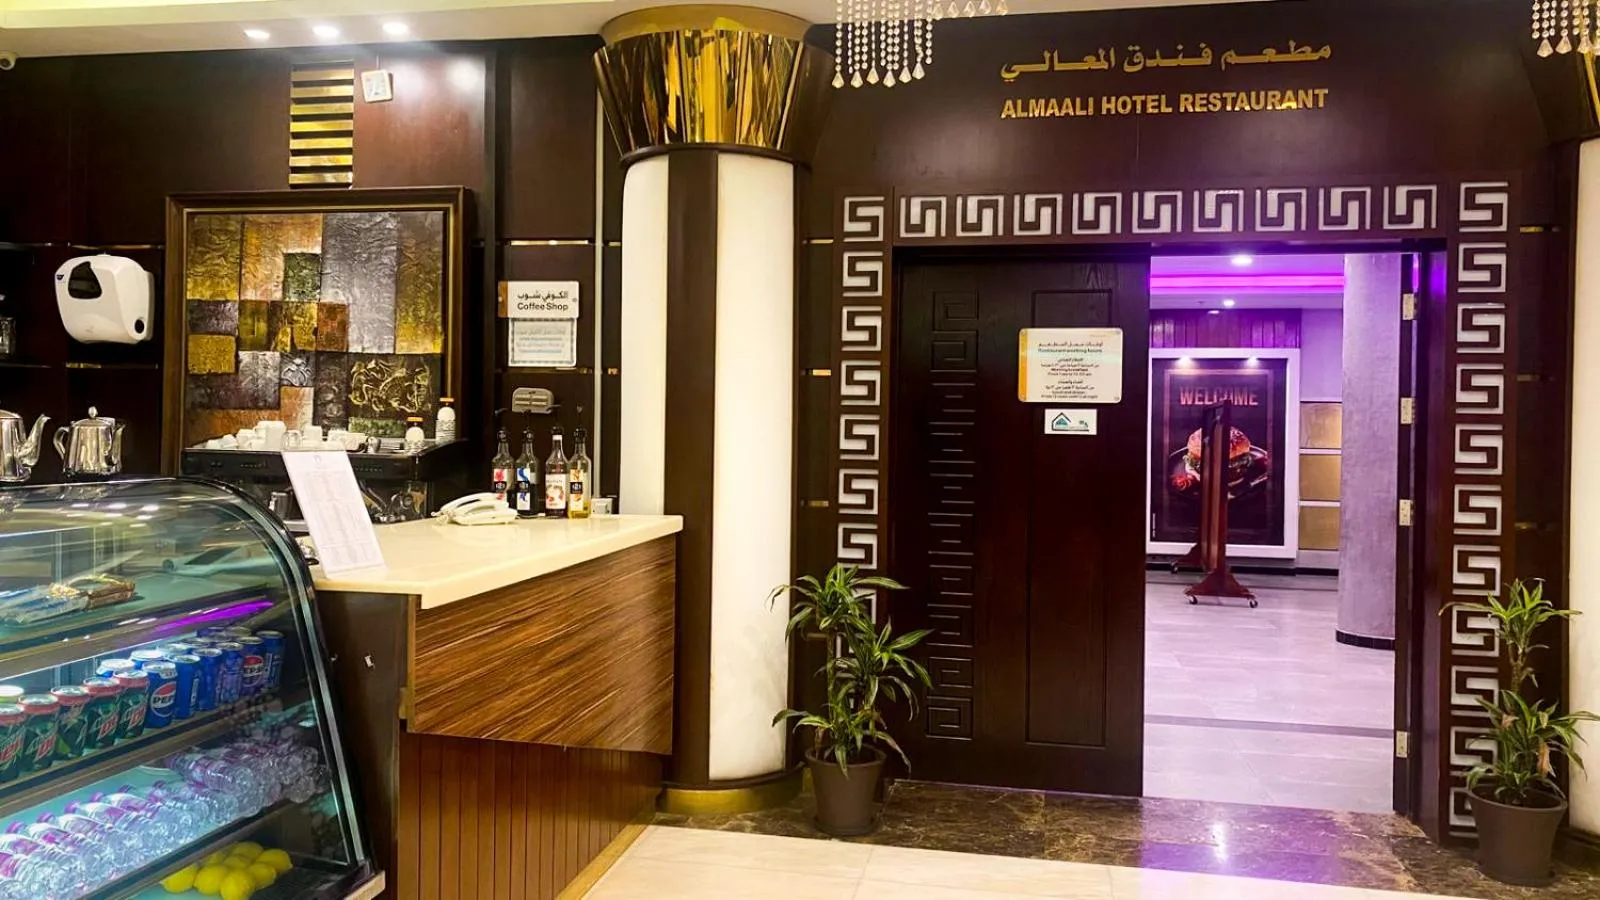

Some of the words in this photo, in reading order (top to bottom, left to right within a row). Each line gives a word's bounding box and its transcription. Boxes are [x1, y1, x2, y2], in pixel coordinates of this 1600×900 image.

[1001, 47, 1116, 83] المعالي
[1123, 42, 1212, 73] فندق
[1220, 39, 1331, 72] مطعم
[1000, 97, 1094, 119] ALMAALI
[1101, 94, 1173, 115] HOTEL
[1179, 88, 1329, 113] RESTAURANT
[517, 302, 545, 310] Coffee
[546, 302, 569, 311] Shop
[1179, 387, 1259, 406] WELCOME
